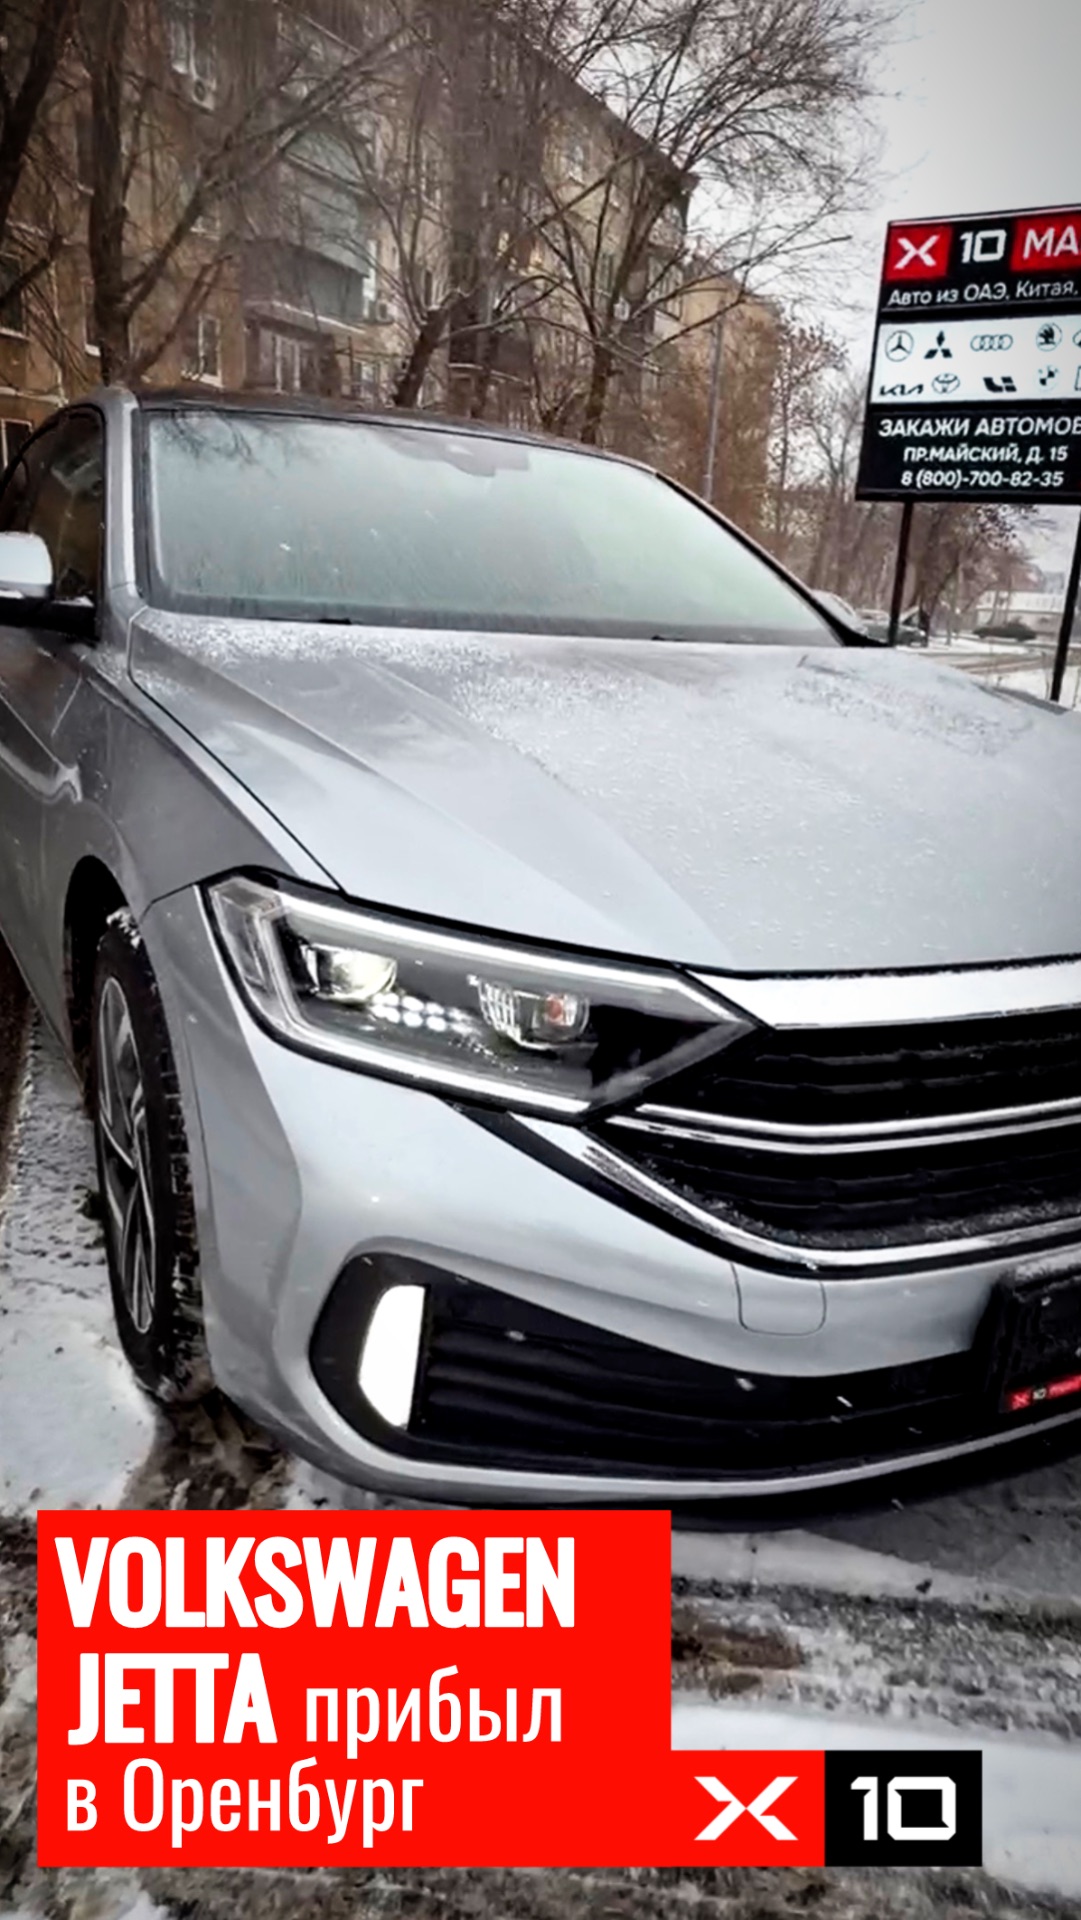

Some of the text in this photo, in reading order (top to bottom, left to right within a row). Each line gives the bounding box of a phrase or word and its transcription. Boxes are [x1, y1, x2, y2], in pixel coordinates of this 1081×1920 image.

[960, 229, 1007, 264] 10
[887, 288, 932, 306] Авто
[936, 289, 959, 304] из
[878, 418, 970, 437] ЗАКАЖИ
[1049, 445, 1068, 461] 15
[901, 469, 1064, 489] 8 (800)-700-82-35
